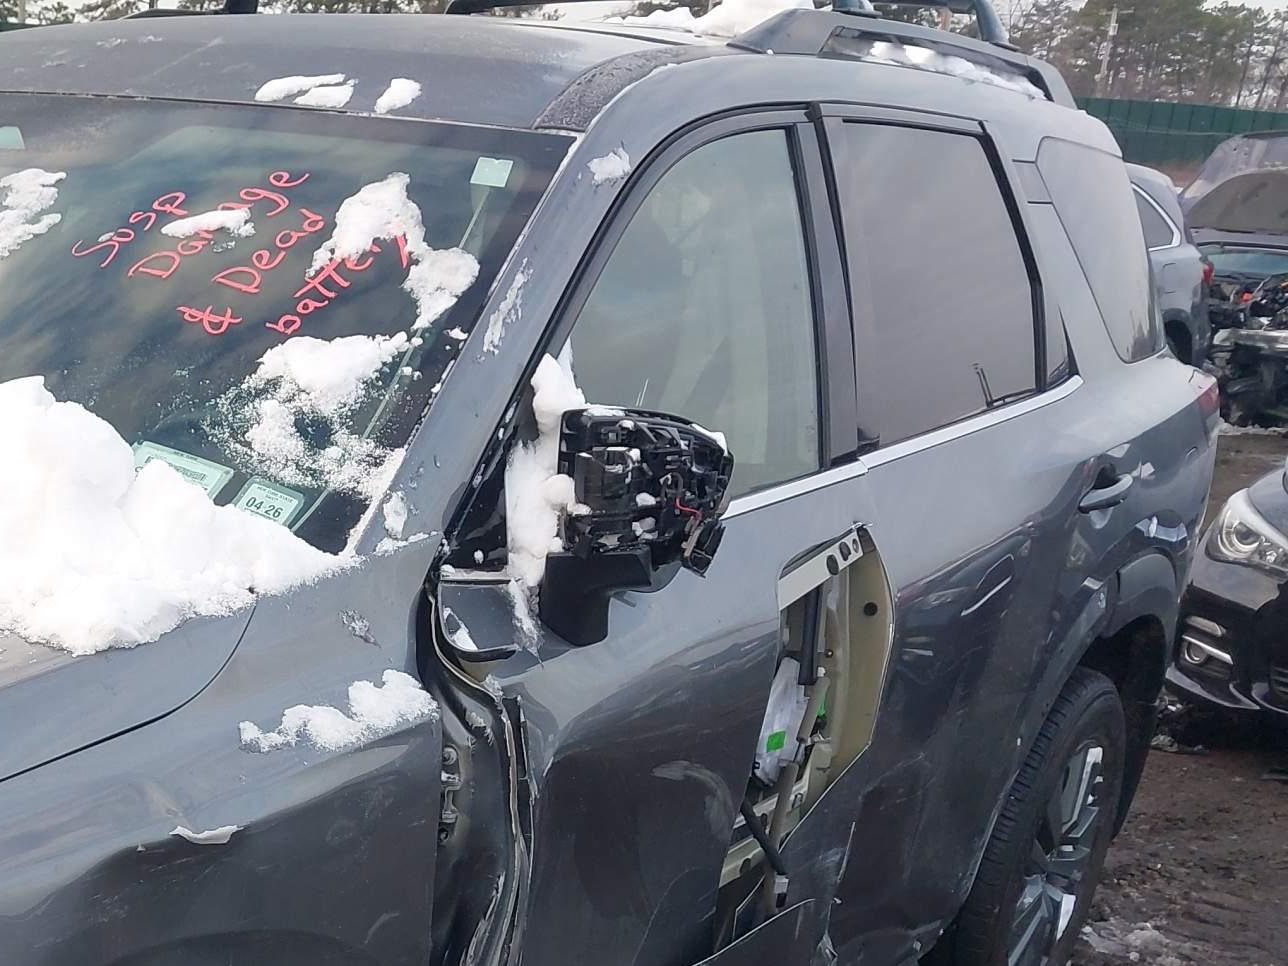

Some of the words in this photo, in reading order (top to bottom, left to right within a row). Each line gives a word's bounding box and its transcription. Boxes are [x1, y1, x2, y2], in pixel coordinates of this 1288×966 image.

[176, 305, 243, 334] &
[212, 208, 325, 294] Dead
[245, 496, 265, 511] 04
[264, 504, 284, 519] 26
